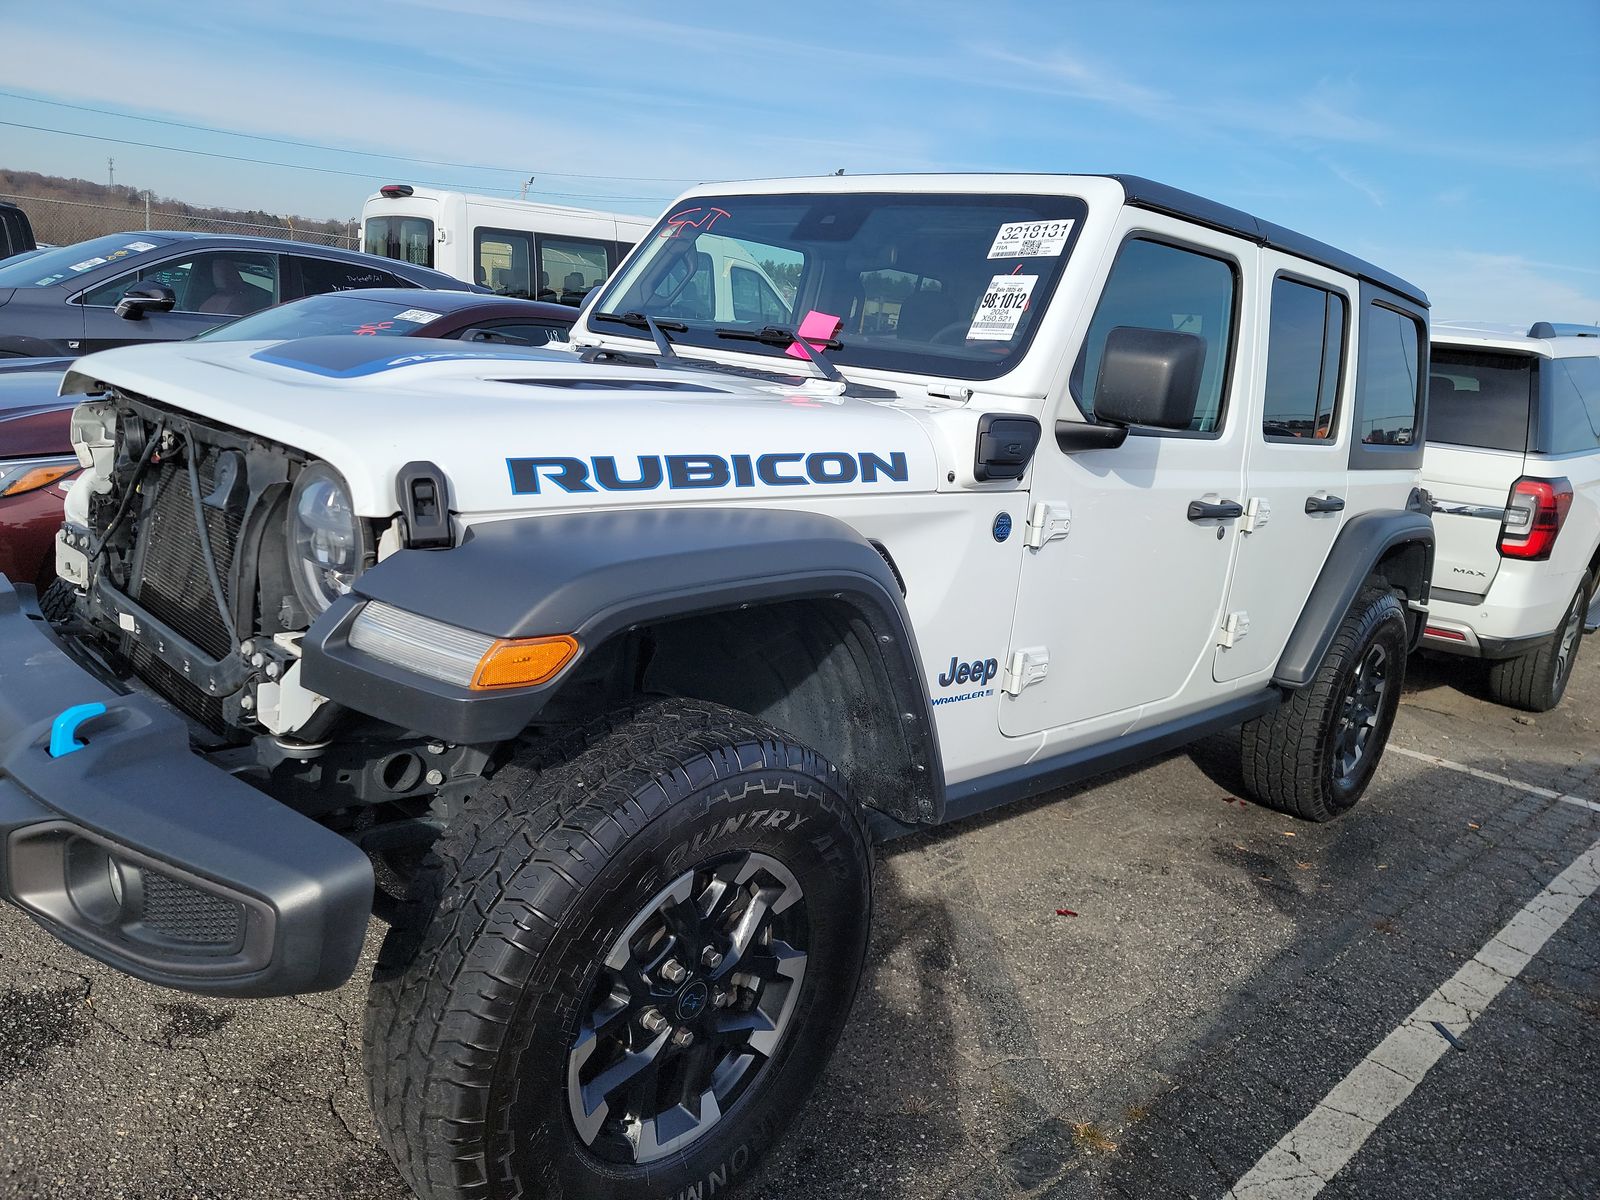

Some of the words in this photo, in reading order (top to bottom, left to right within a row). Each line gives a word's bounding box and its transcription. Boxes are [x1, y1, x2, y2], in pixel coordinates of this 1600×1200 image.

[1002, 223, 1068, 240] 3218131
[981, 292, 1027, 309] 98:1012
[990, 308, 1010, 316] 2024
[505, 452, 909, 495] RUBICON
[1453, 567, 1486, 577] MAX
[938, 656, 998, 687] Jeep
[931, 690, 985, 706] WRANGLER
